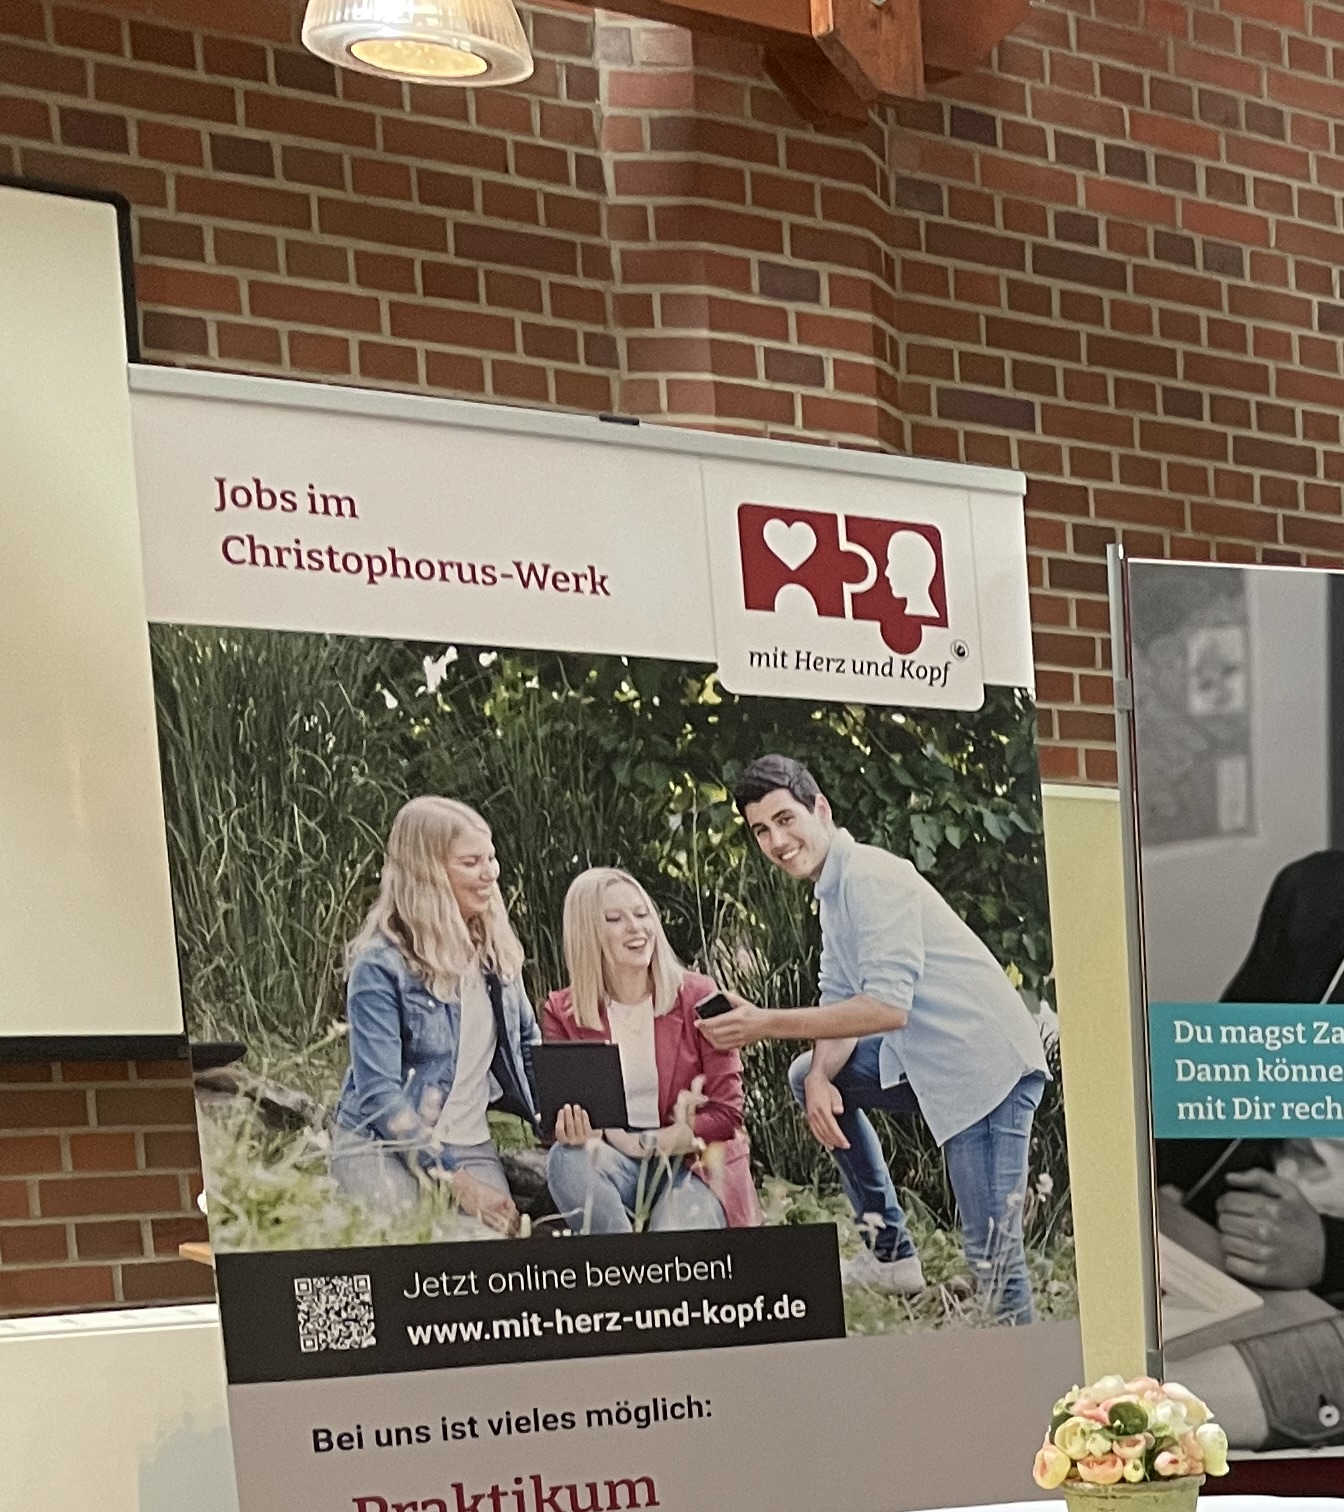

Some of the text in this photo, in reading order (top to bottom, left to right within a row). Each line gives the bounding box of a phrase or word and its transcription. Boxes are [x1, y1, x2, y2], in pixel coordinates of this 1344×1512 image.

[213, 476, 360, 519] Jobs im
[221, 534, 612, 597] Christophorus-Werk
[749, 647, 952, 688] mit Herz und Kopf
[1174, 1020, 1213, 1044] Du
[1220, 1022, 1307, 1051] magst
[1175, 1058, 1250, 1082] Dann
[1177, 1096, 1226, 1120] mit
[1232, 1096, 1276, 1120] Dir
[403, 1254, 734, 1298] Jetzt online bewerben!
[406, 1294, 807, 1346] www.mit-herz-und-kopf.de
[312, 1395, 713, 1453] Bei uns ist vieles möglich:
